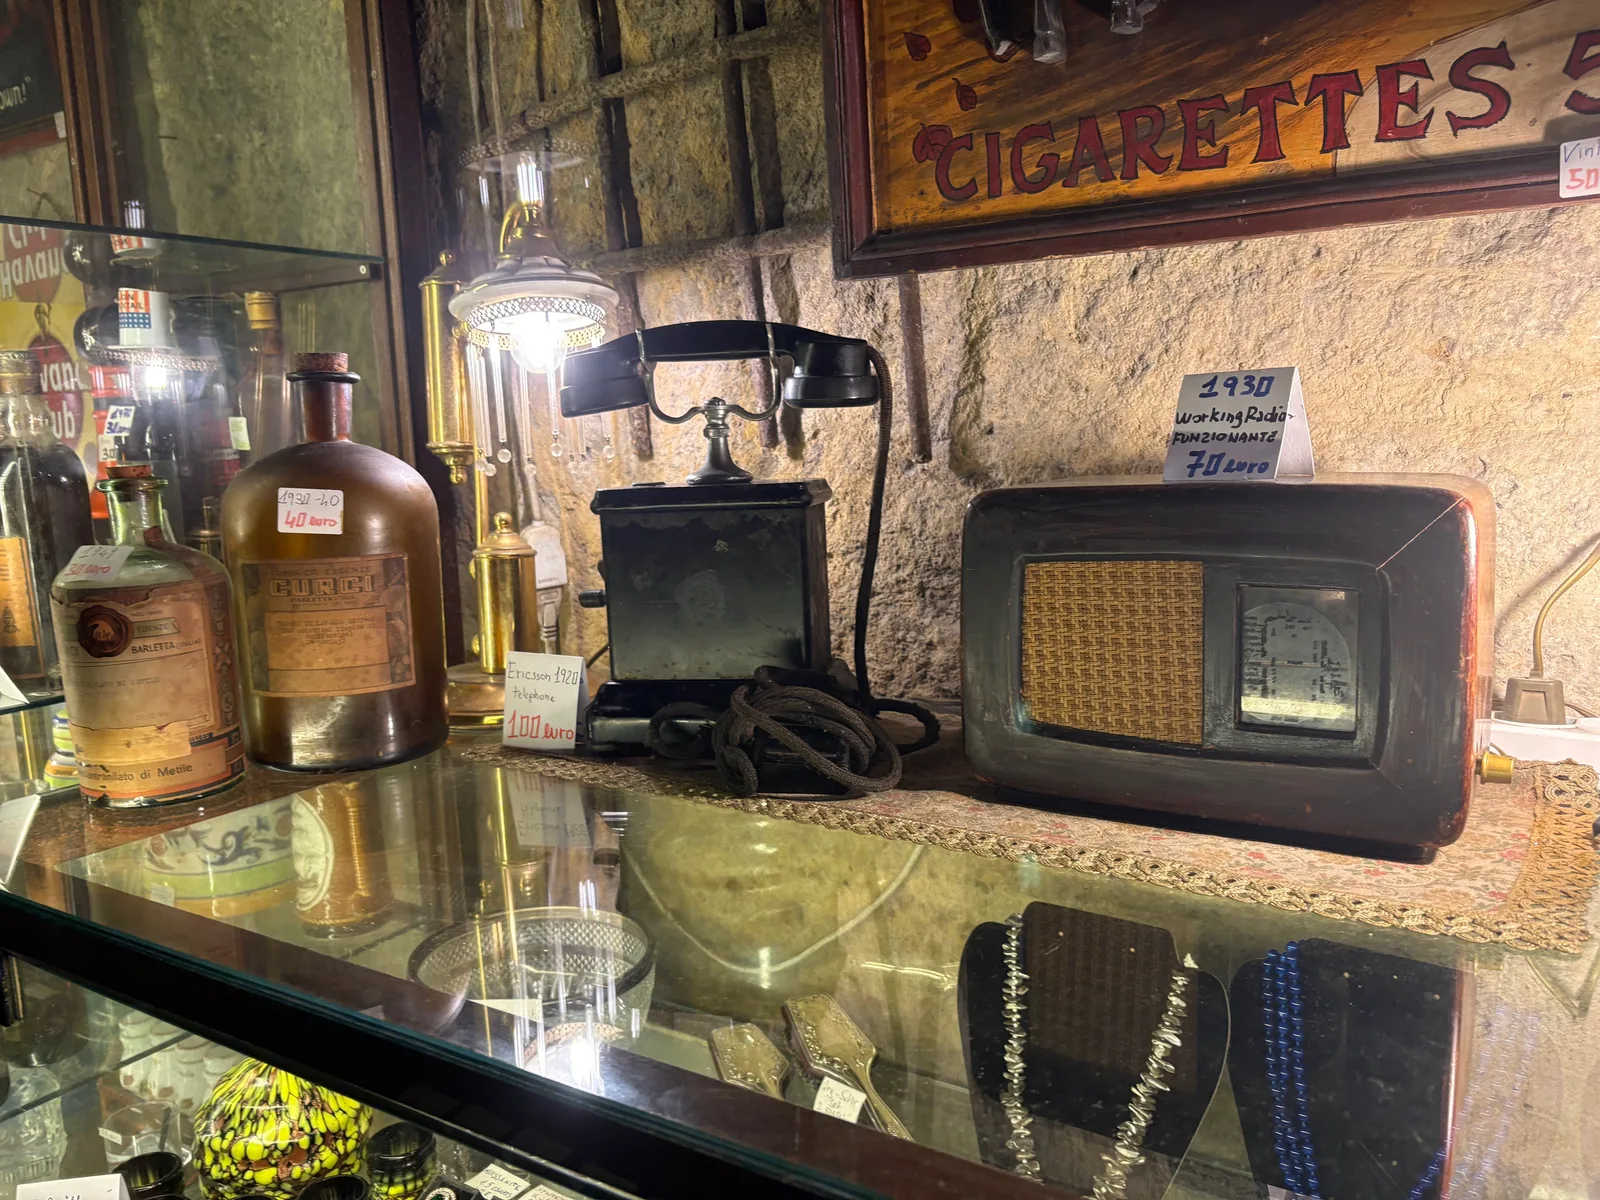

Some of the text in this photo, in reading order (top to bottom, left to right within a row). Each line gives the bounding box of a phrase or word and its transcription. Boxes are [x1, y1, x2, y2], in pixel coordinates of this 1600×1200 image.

[935, 41, 1516, 200] CIGARETTES
[1199, 375, 1275, 398] 1930
[1172, 430, 1278, 445] FUNZIONANTE
[1187, 450, 1270, 478] 70 euro
[284, 510, 338, 528] 40 euro
[131, 641, 175, 654] BARLETTA
[508, 661, 578, 685] Ericsson 1920
[513, 686, 555, 703] telephone
[508, 710, 574, 740] 100 euro
[140, 769, 151, 780] di
